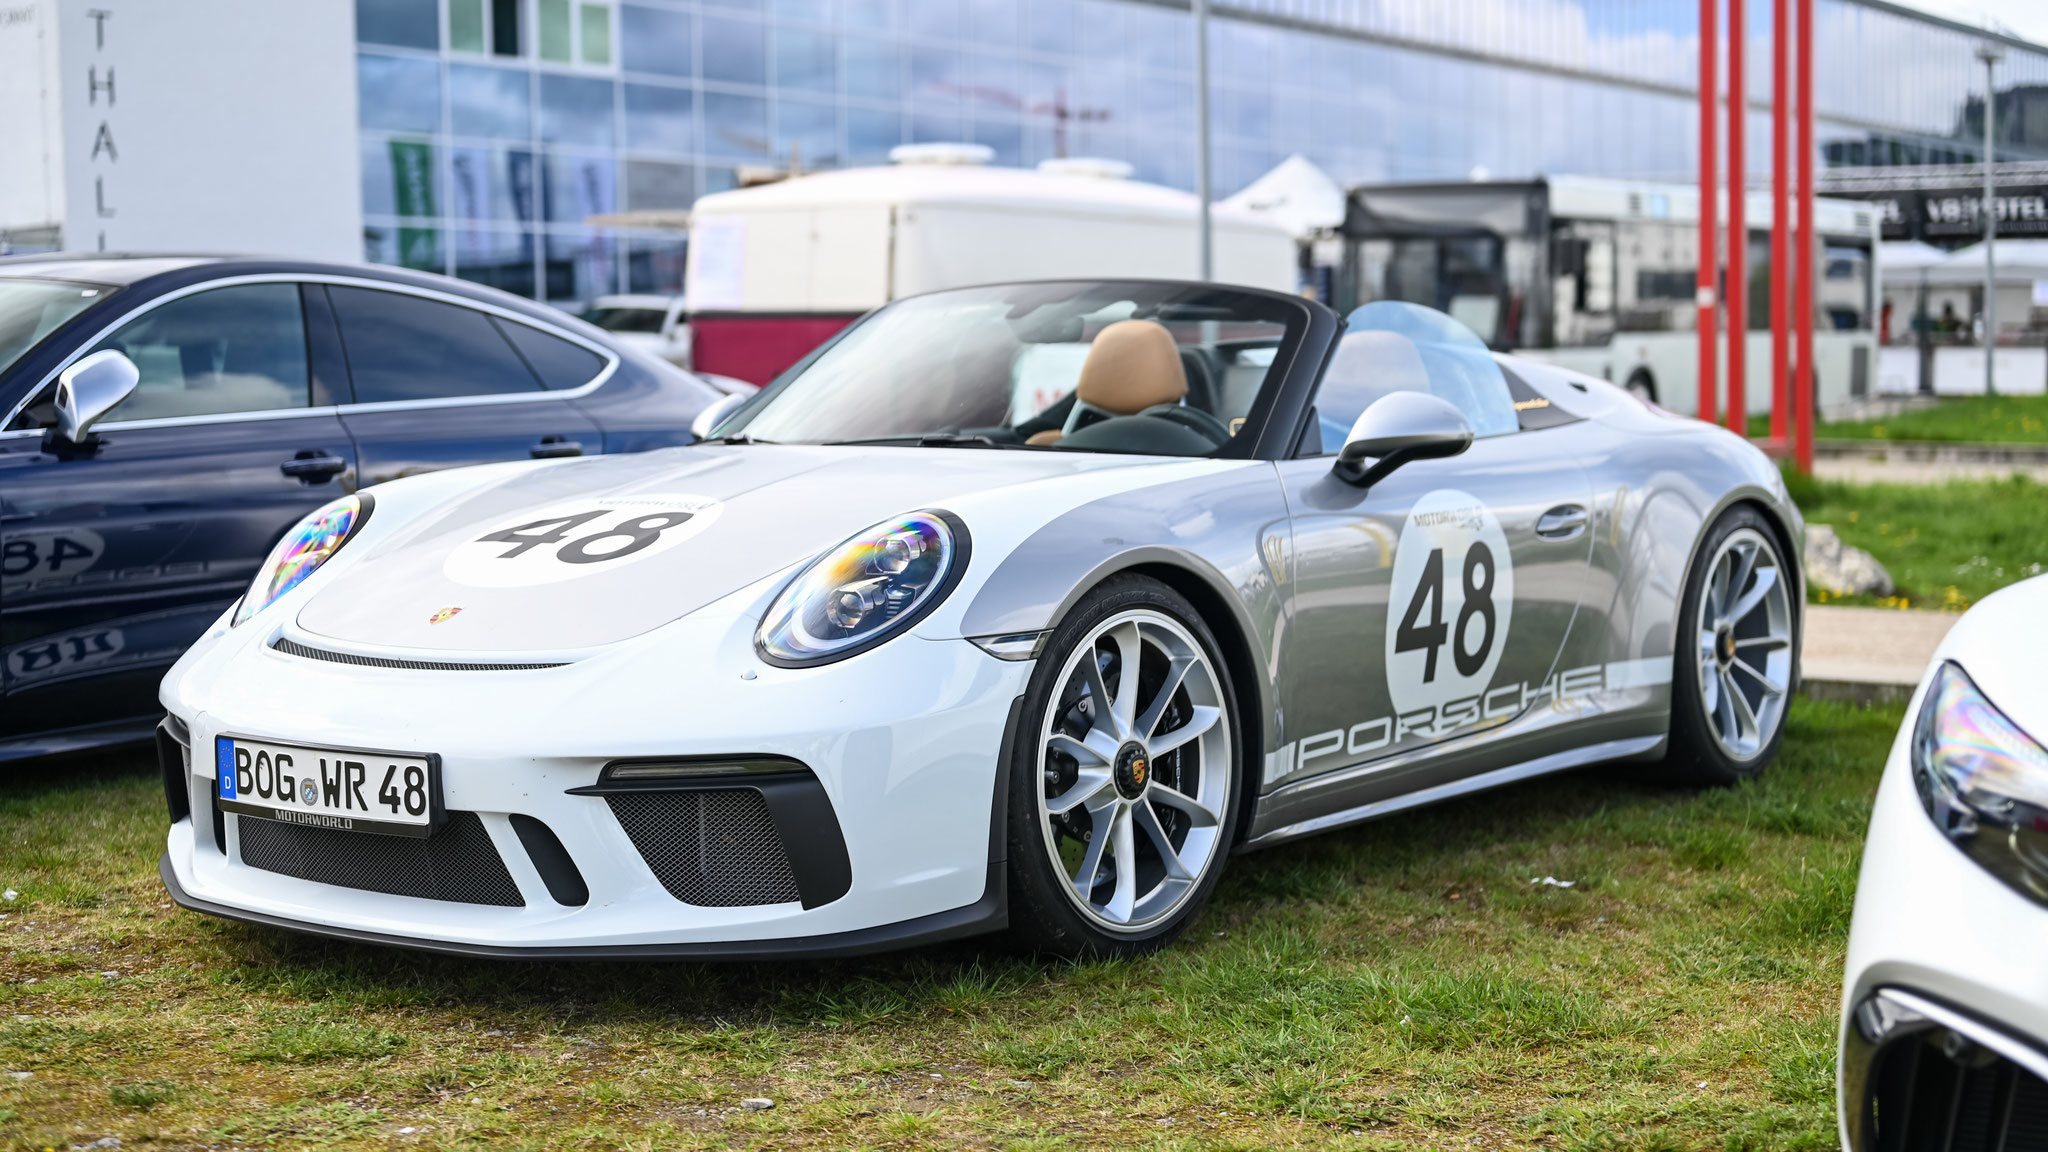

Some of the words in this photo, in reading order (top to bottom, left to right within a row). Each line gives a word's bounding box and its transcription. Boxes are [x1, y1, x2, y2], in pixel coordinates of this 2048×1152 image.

[474, 509, 694, 564] 48
[1395, 541, 1496, 684] 48
[1297, 665, 1602, 770] PORSCHE
[235, 747, 296, 802] BOG
[320, 758, 369, 812] WR
[379, 764, 426, 816] 48
[275, 809, 353, 830] MOTORWORLD
